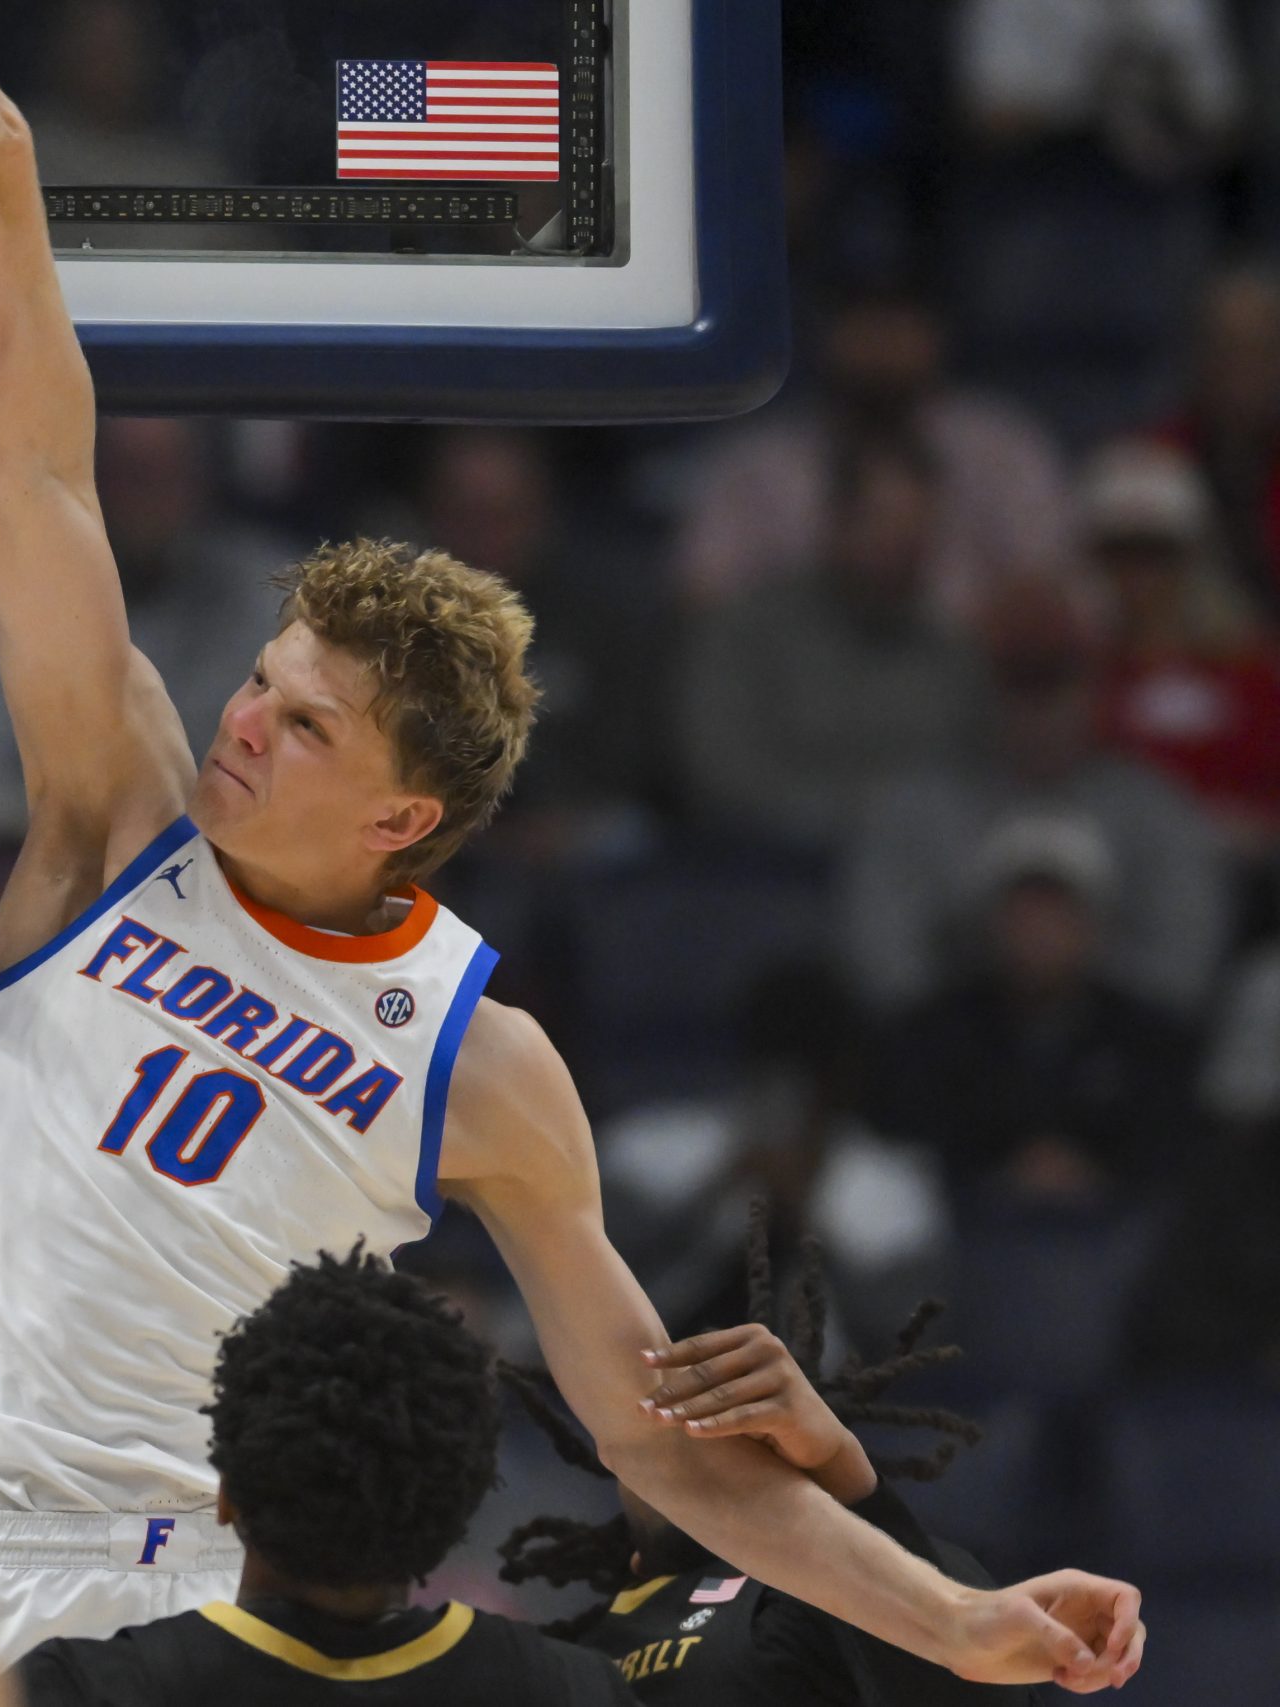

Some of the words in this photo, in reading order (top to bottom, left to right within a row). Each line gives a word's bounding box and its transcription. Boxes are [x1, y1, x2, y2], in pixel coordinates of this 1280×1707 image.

[77, 915, 405, 1135] FLORIDA
[378, 991, 411, 1025] SEC
[97, 1044, 268, 1187] 10
[136, 1517, 176, 1565] F
